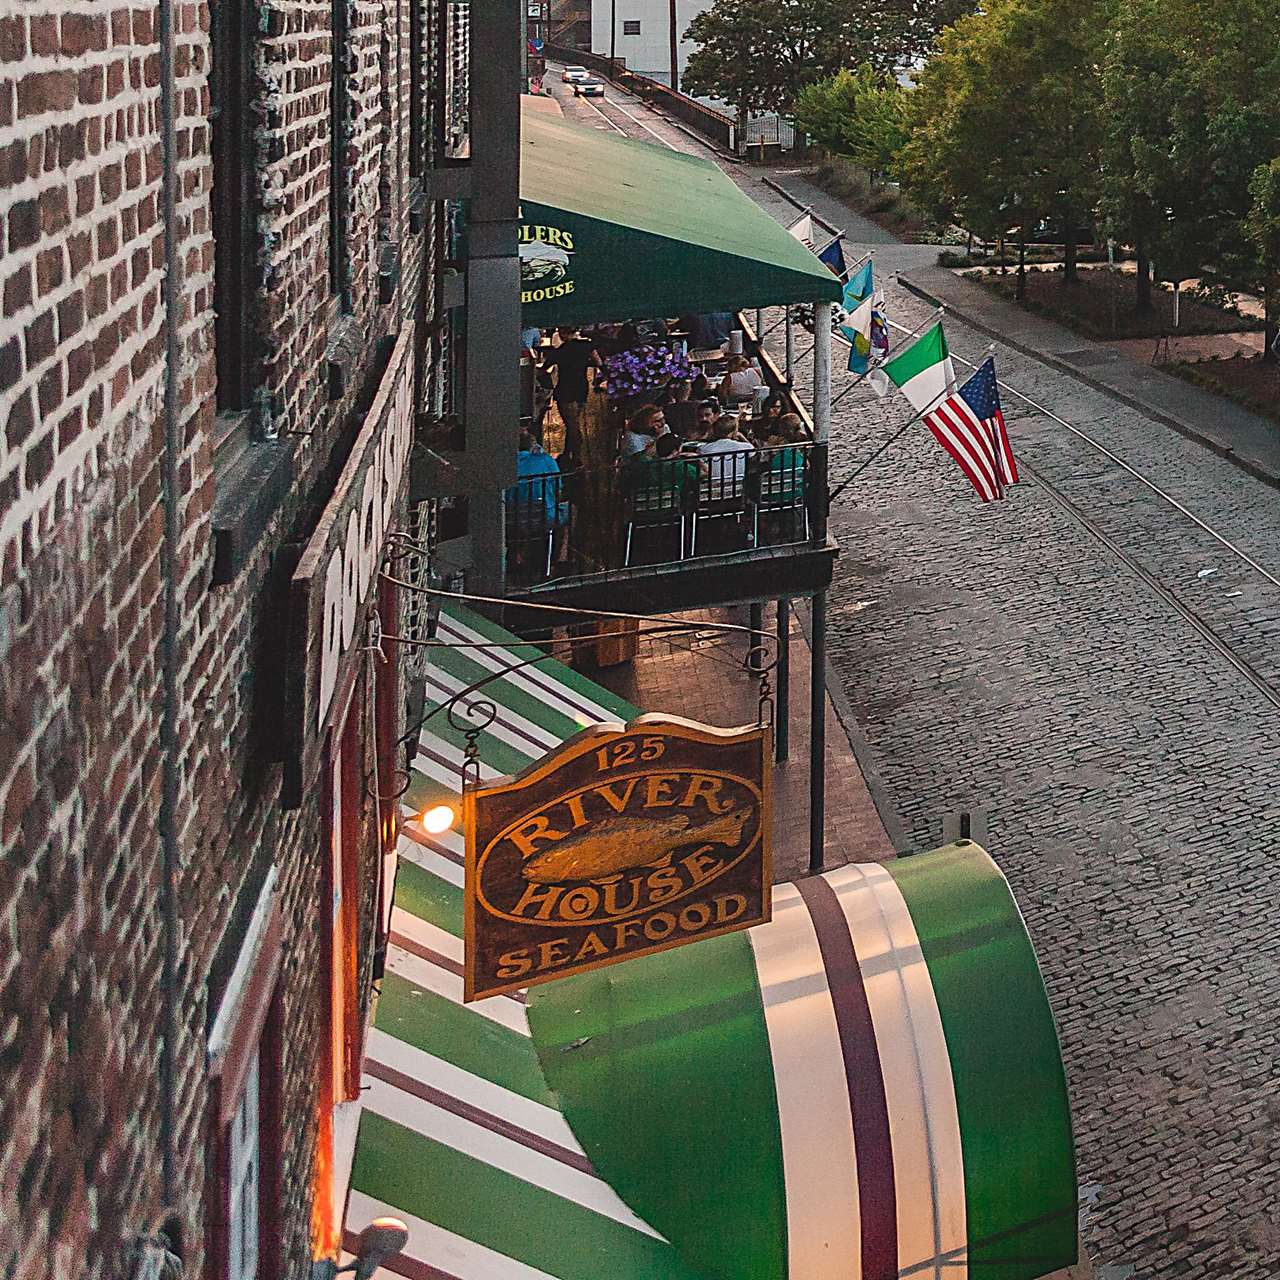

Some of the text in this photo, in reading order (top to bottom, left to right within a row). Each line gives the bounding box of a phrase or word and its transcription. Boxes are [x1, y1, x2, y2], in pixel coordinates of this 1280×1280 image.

[518, 225, 574, 249] LERS
[521, 281, 575, 303] HOUSE
[318, 348, 412, 731] DOCKSIDE
[598, 736, 666, 772] 125
[505, 774, 734, 859] RIVER
[511, 846, 725, 920] HOUSE
[496, 894, 749, 979] SEAFOOD
